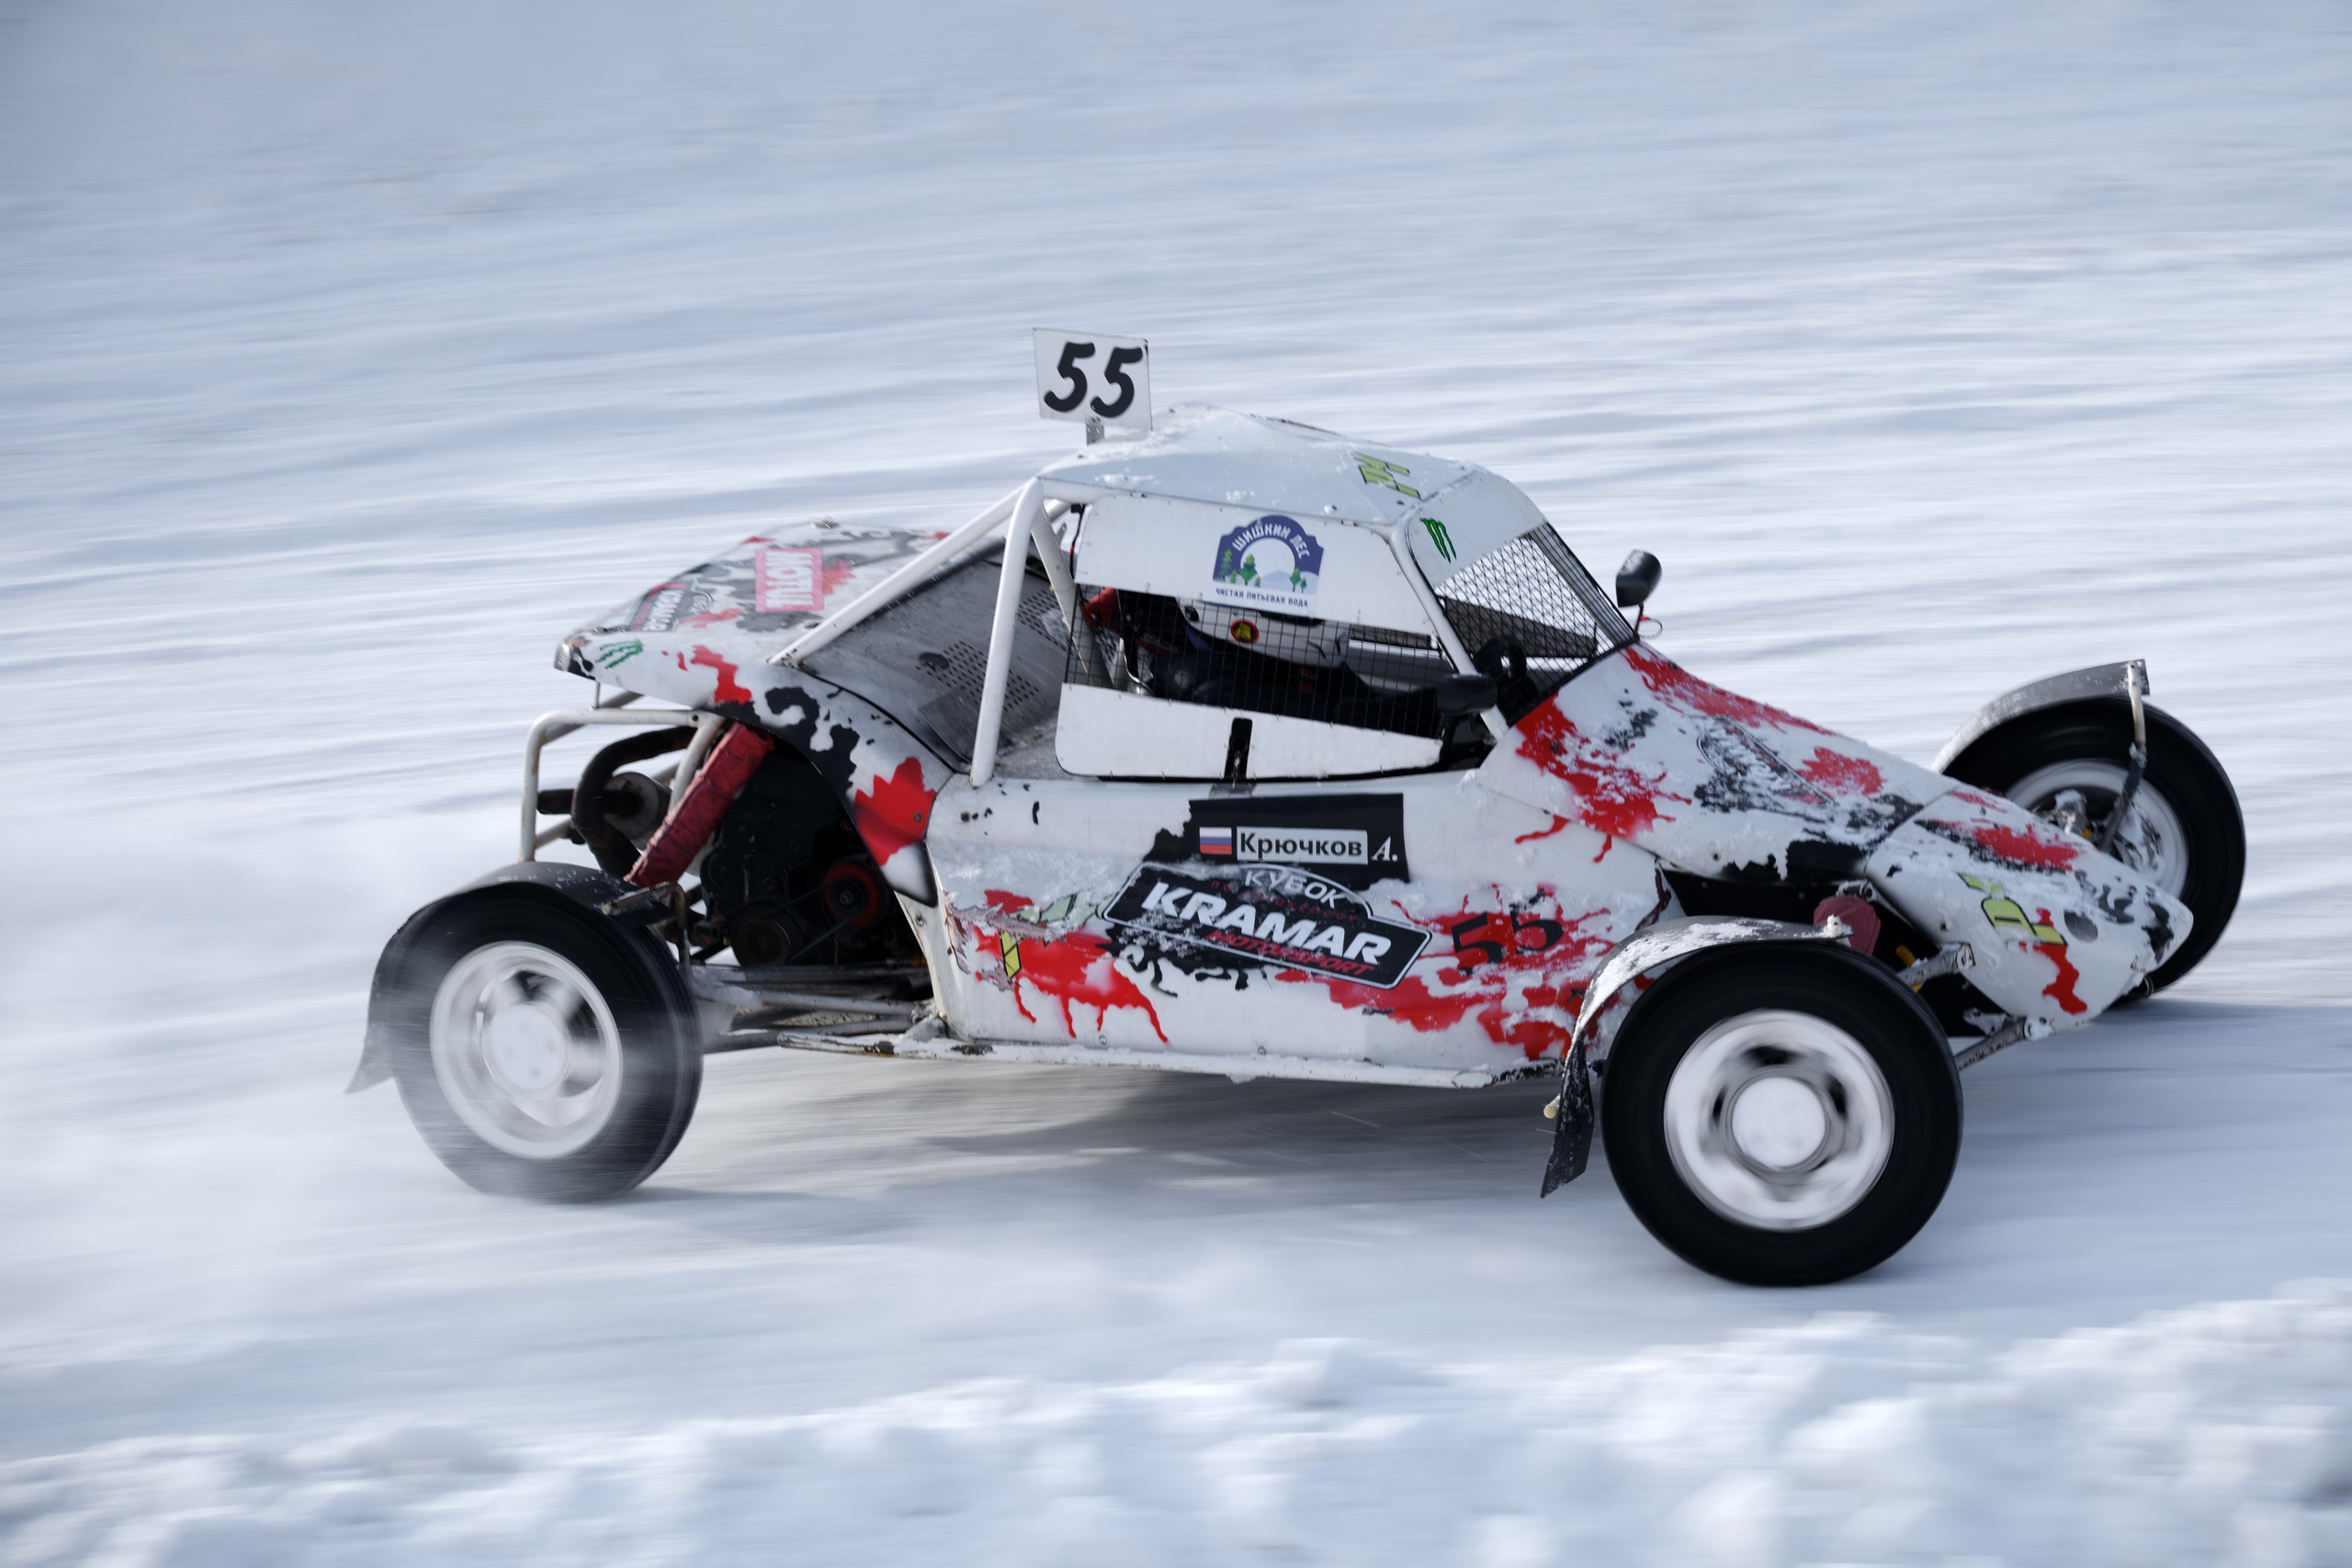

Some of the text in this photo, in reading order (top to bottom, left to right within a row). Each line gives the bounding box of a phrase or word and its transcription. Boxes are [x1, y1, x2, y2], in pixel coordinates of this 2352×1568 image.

[1044, 341, 1143, 418] 55
[1232, 524, 1291, 551] ШИШКИН
[1216, 588, 1308, 607] ЧИСТАЯ ПИТЬЕВАЯ ВОДА
[1240, 831, 1362, 860] Крючков
[1245, 870, 1348, 909] КУБОК
[1141, 882, 1392, 964] KRAMAR
[1204, 930, 1376, 976] MOTORSPORT
